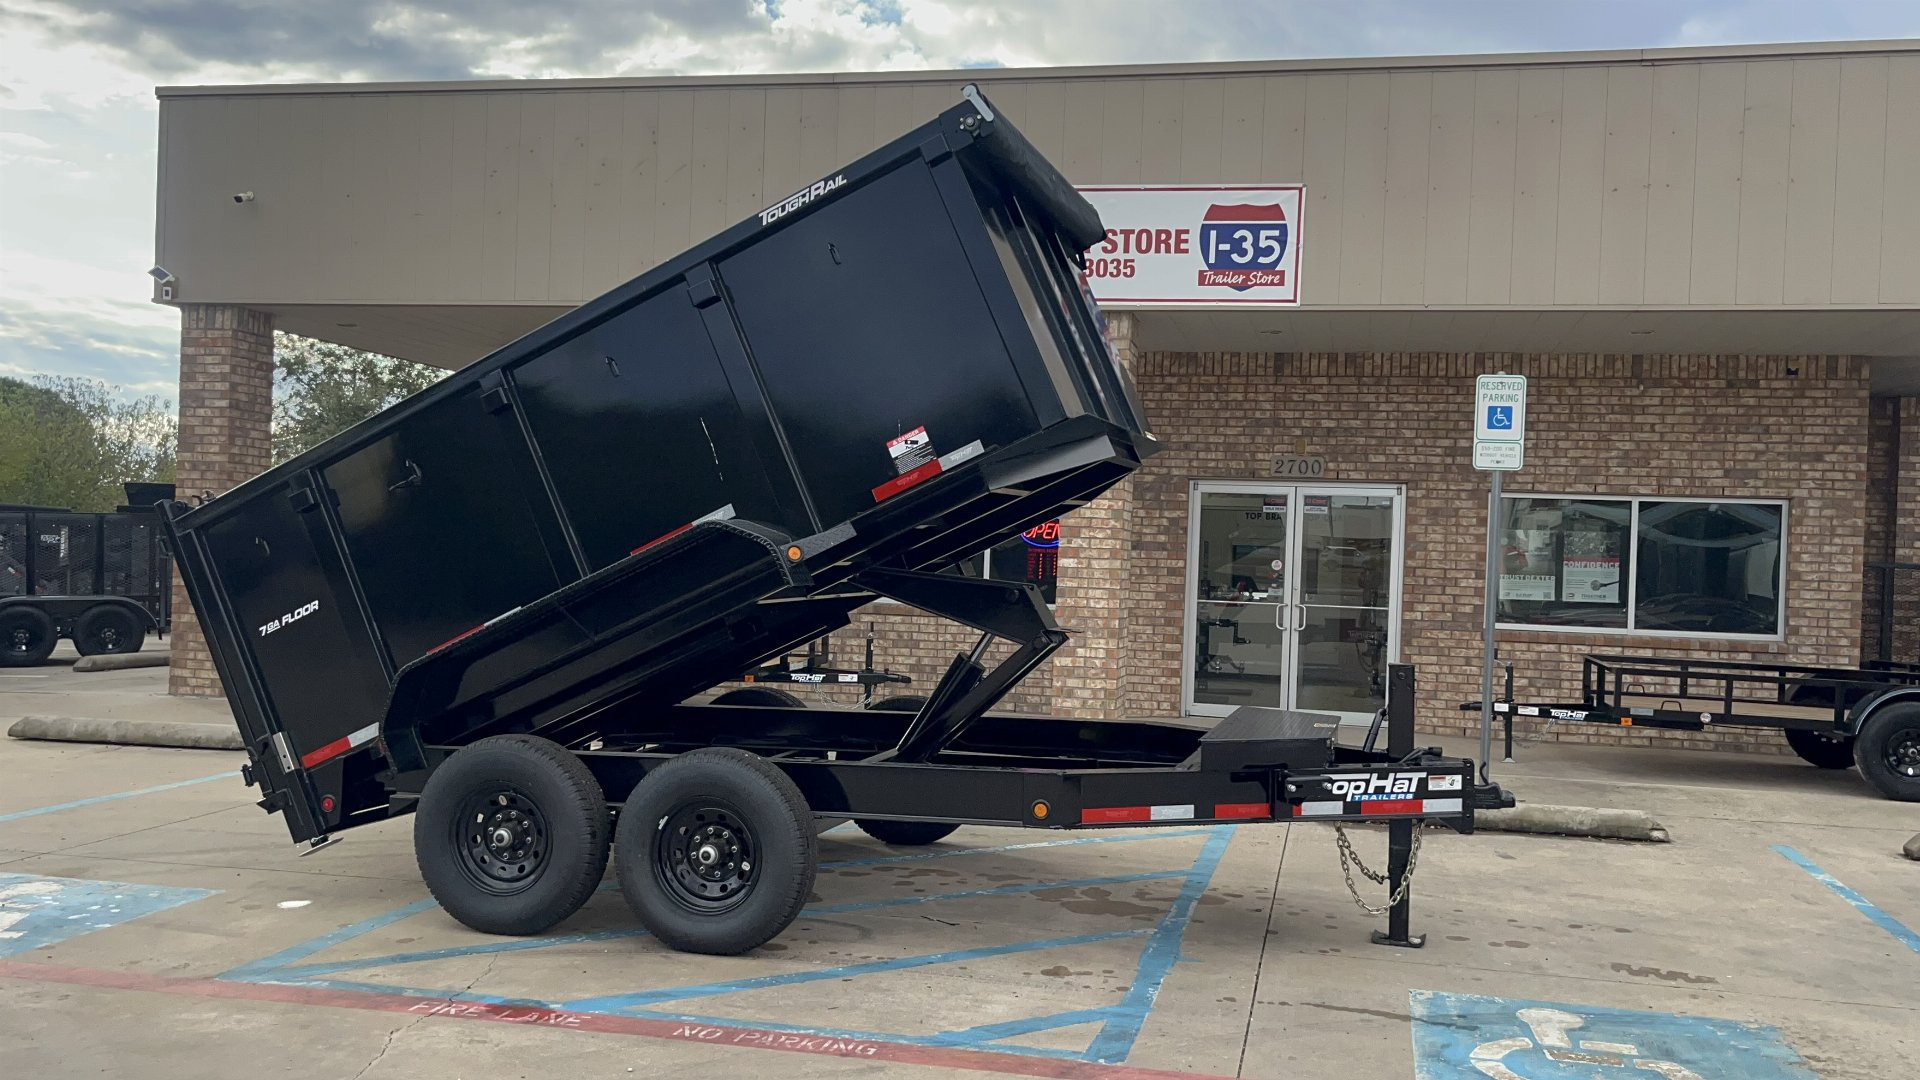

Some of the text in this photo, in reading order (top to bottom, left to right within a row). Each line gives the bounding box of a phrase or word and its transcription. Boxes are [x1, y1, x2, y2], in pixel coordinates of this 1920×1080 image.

[1102, 228, 1190, 254] STORE
[1208, 229, 1281, 264] I-35
[1203, 271, 1281, 285] Trailer Store
[1480, 381, 1523, 391] RESERVED
[1482, 393, 1519, 403] PARKING
[1274, 459, 1323, 476] 2700
[1562, 560, 1620, 569] CONFIDENCE
[282, 600, 319, 626] FLOOR
[1353, 793, 1414, 801] TRAILERS
[408, 1001, 592, 1027] FIRE LANE
[672, 1025, 879, 1056] NO PARKING
